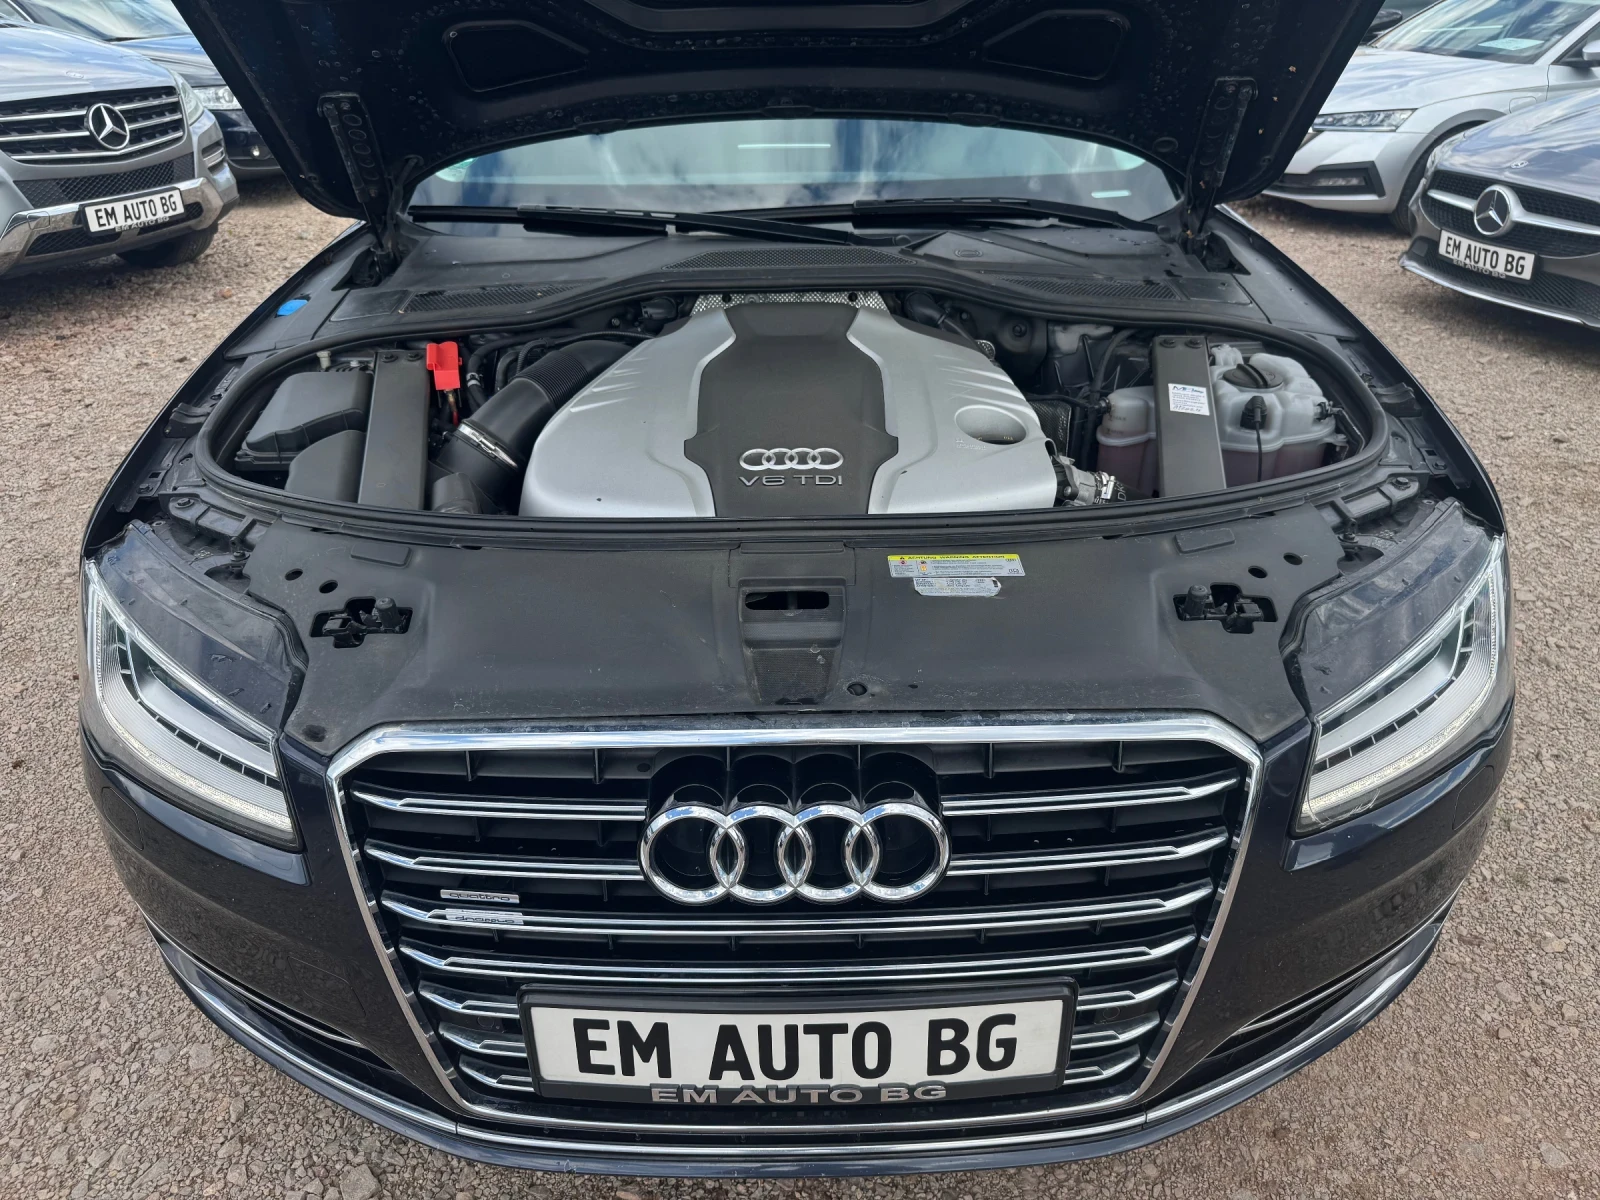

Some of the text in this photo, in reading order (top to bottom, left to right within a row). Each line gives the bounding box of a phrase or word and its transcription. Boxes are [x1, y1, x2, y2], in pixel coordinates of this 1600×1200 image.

[94, 194, 177, 227] EM AUTO BG
[115, 224, 129, 232] EM
[131, 219, 155, 230] AUTO
[1445, 237, 1525, 275] EM AUTO BG
[1465, 263, 1489, 274] AUTO
[739, 475, 843, 486] V6 TDI
[449, 892, 511, 902] quattro
[573, 1013, 1017, 1080] EM AUTO BG
[650, 1081, 947, 1104] EM AUTO BG
